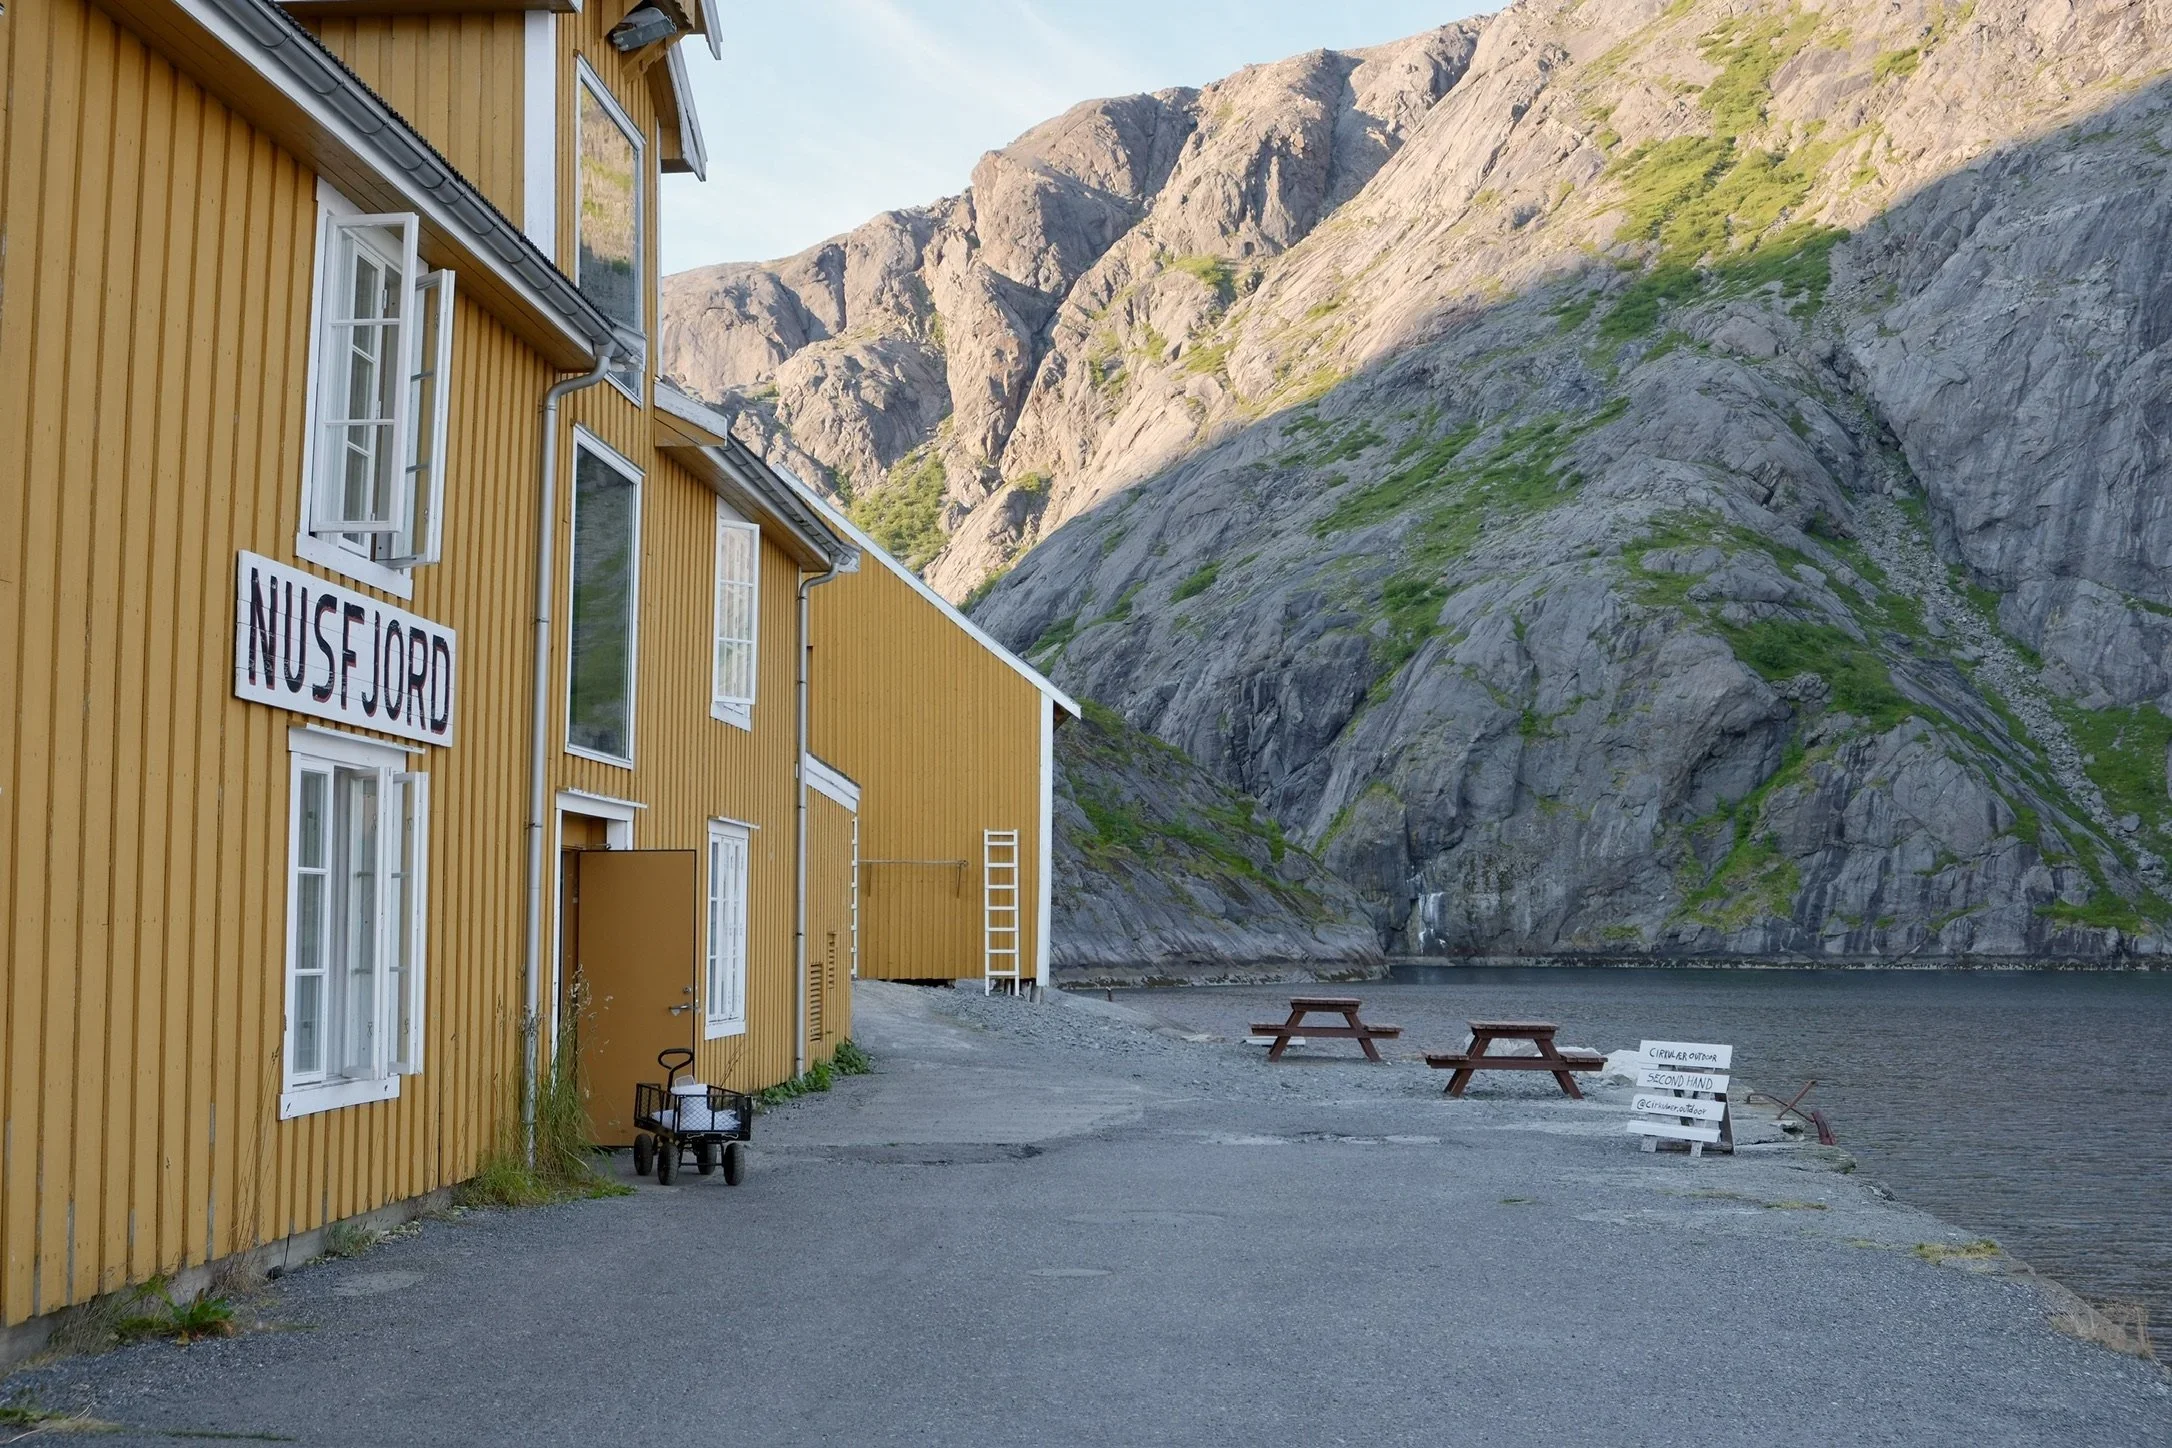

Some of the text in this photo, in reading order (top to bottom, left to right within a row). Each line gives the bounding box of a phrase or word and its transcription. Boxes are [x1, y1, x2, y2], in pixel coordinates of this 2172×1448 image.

[249, 567, 451, 735] NUSFJORD
[1688, 1052, 1718, 1062] OUTDOOR
[1647, 1072, 1714, 1091] SECOND HAND
